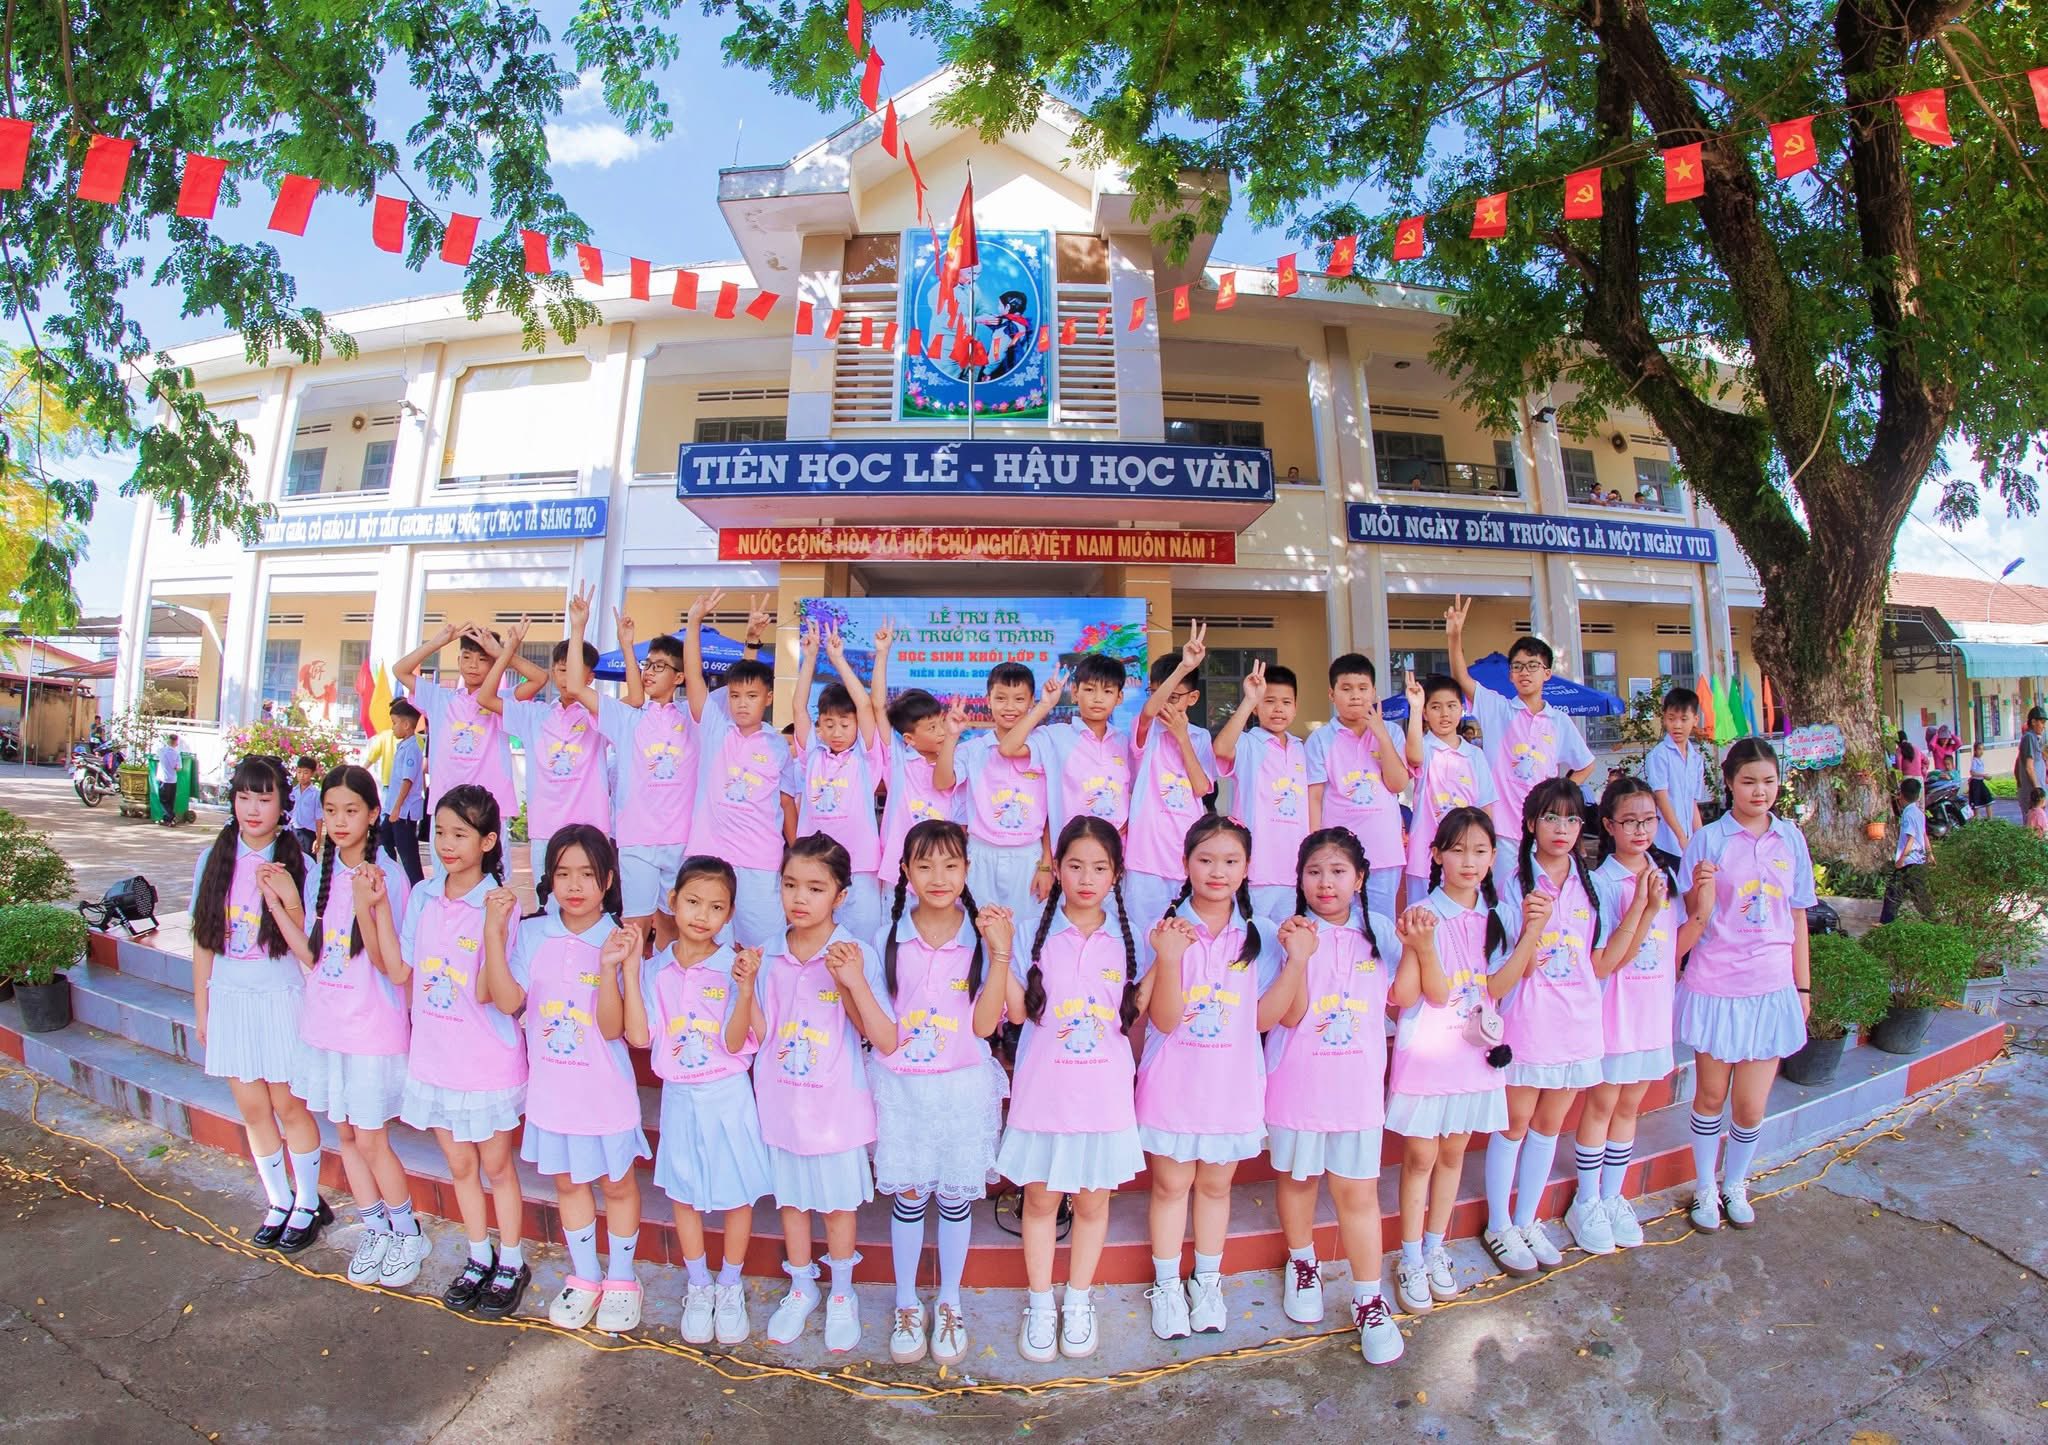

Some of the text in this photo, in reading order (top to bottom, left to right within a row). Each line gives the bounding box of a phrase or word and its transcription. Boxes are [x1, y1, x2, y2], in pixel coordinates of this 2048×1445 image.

[693, 442, 1261, 492] TIÊN HỌC LỄ - HẬU HỌC VĂN
[483, 508, 498, 536] TỰ
[499, 509, 522, 536] HỌC
[524, 504, 538, 531] VÀ
[540, 502, 572, 529] SÁNG
[574, 506, 597, 533] TẠO
[1359, 505, 1711, 557] MỖI NGÀY ĐẾN TRƯỜNG LÀ MỘT NGÀY VUI
[738, 529, 782, 554] NƯỚC
[786, 529, 833, 559] CỘNG
[836, 529, 870, 554] HÒA
[879, 528, 899, 554] XÃ
[904, 529, 932, 559] HỘI
[937, 529, 972, 554] CHỦ
[976, 529, 1030, 555] NGHĨA
[1032, 530, 1071, 560] VIỆT
[1076, 535, 1113, 556] NAM
[1118, 531, 1165, 557] MUÔN
[1170, 532, 1205, 558] NĂM
[956, 611, 988, 624] TRI
[917, 625, 990, 643] TRƯỞNG
[898, 648, 1048, 664] HỌC SINH KHỐI LỚP 5
